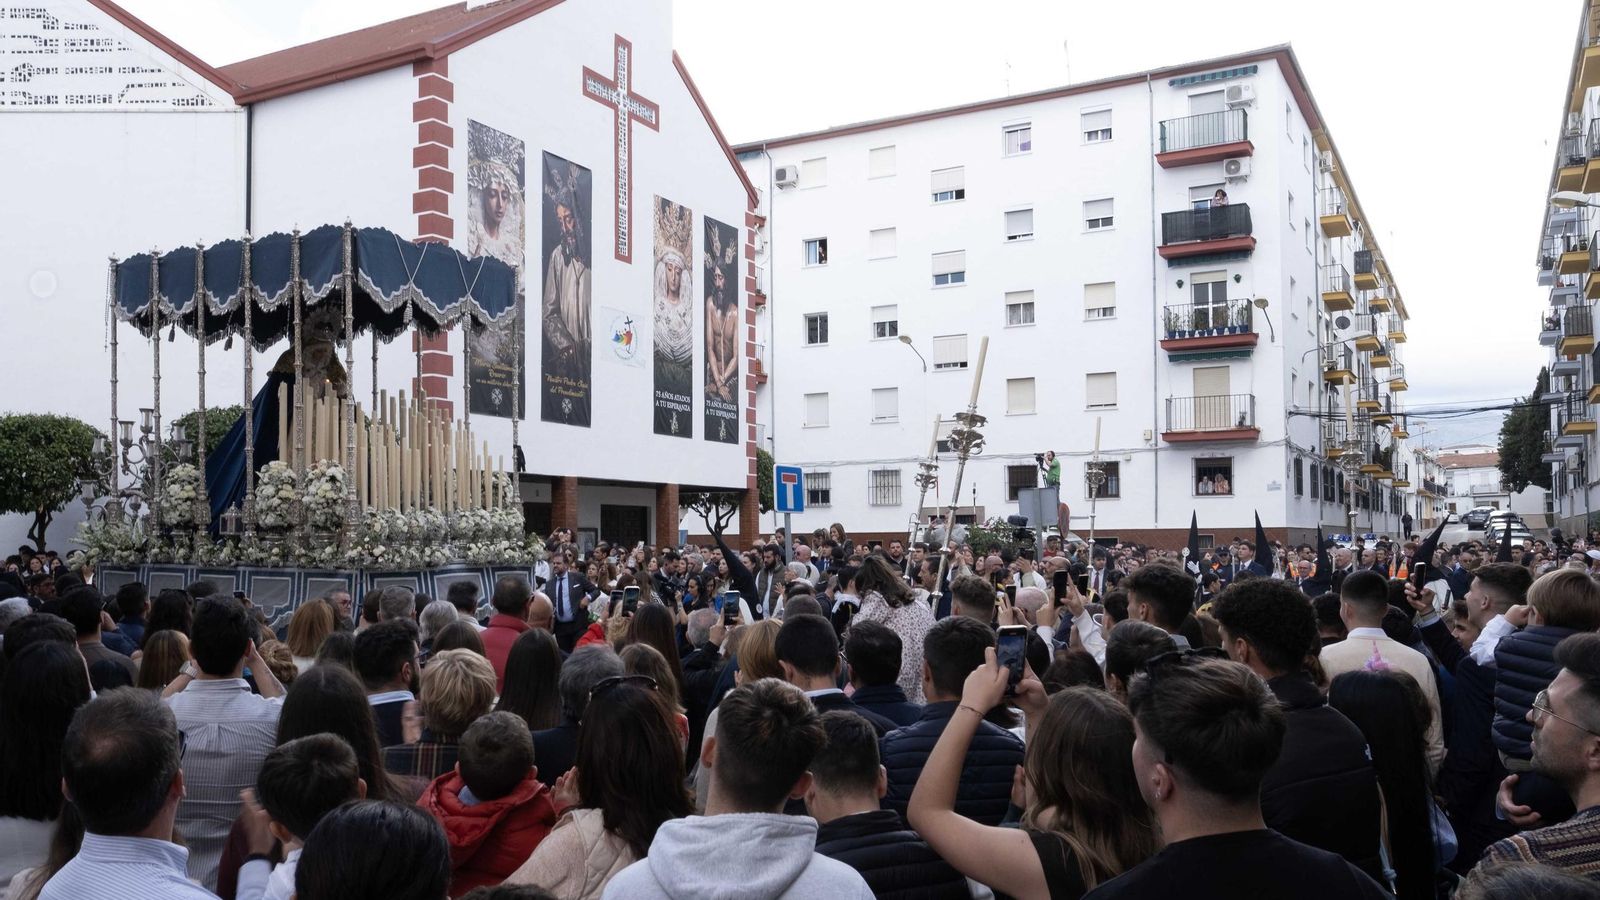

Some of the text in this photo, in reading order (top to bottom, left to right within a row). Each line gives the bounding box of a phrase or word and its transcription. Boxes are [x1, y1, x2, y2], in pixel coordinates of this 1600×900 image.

[655, 390, 691, 403] 75 AÑOS ATADOS
[660, 400, 667, 408] TU
[667, 402, 691, 412] ESPERANZA
[711, 400, 722, 409] AÑOS
[722, 402, 737, 411] ATADOS
[706, 408, 737, 420] A TU ESPERANZA
